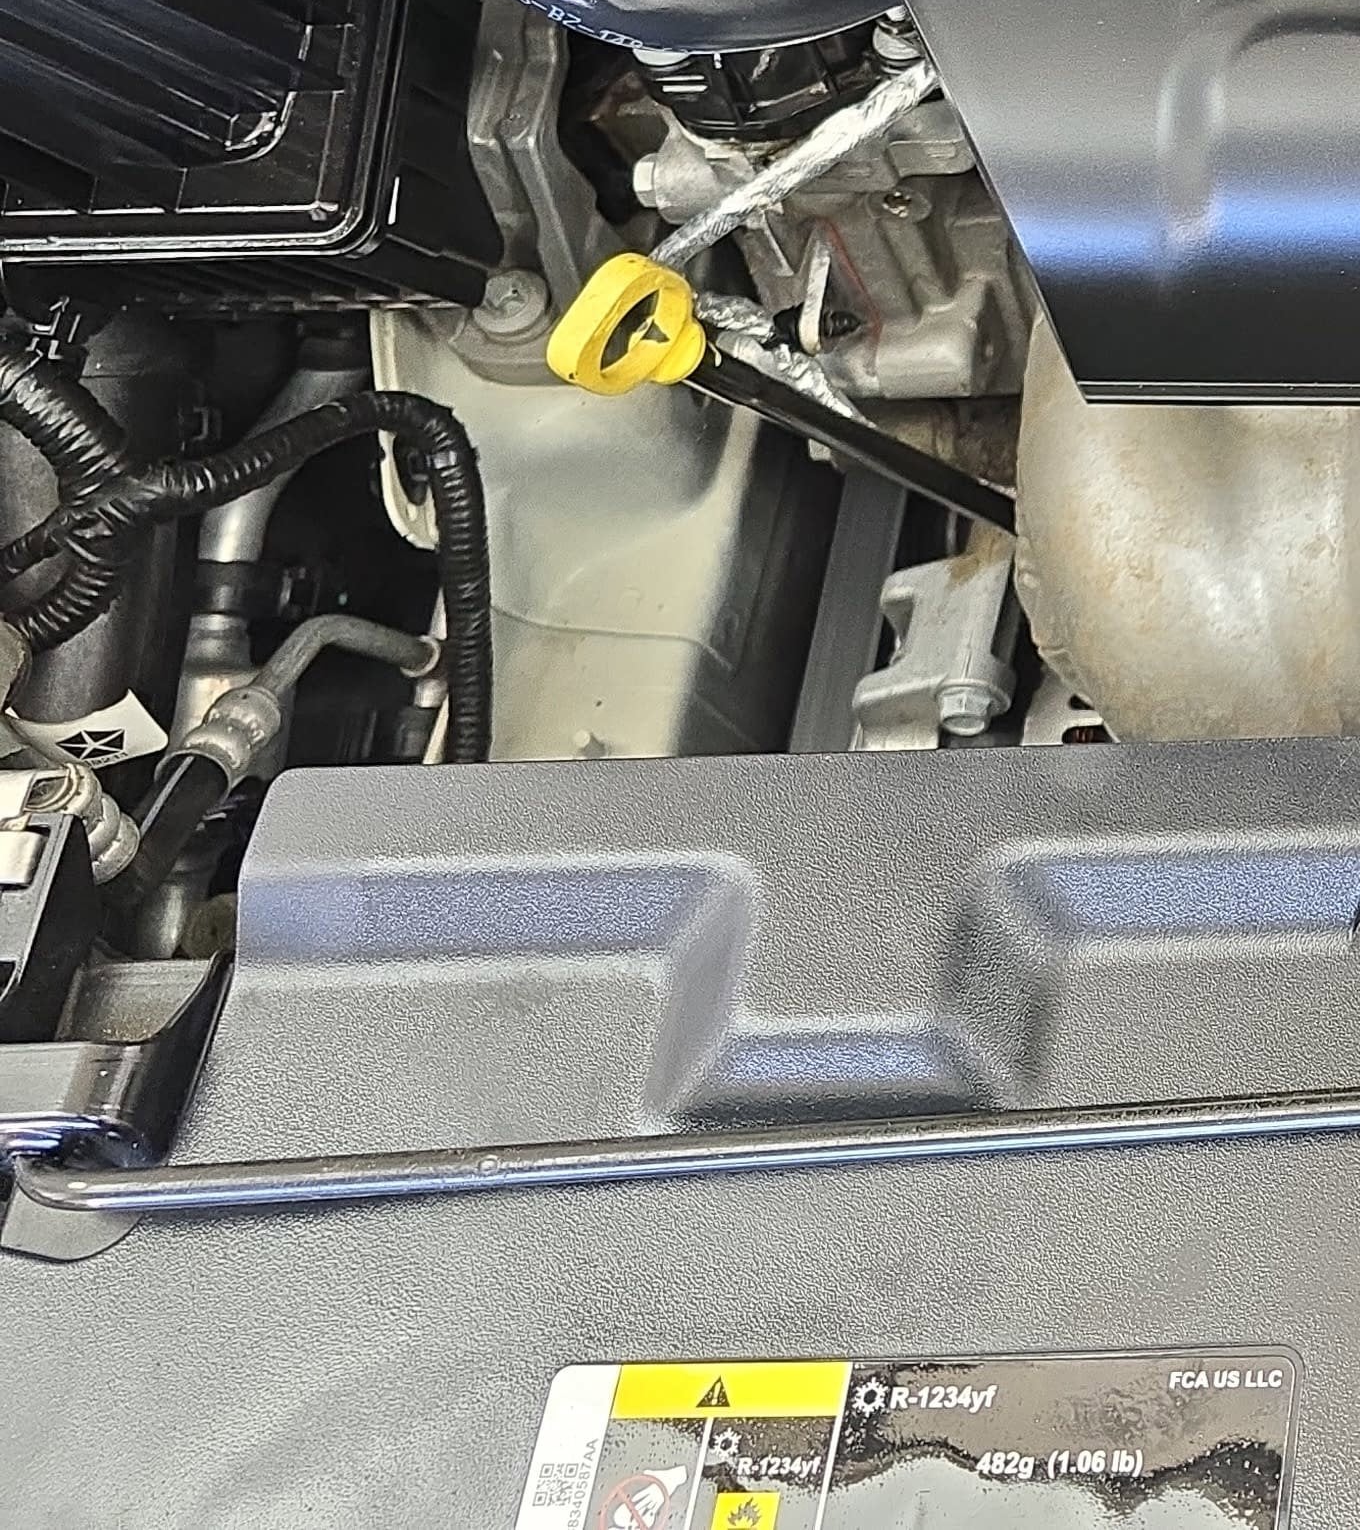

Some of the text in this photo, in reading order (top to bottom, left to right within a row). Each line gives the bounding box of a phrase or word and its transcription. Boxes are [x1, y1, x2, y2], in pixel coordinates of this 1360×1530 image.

[1168, 1368, 1284, 1391] FCA US LLC
[888, 1384, 998, 1413] R-1234yf
[736, 1455, 821, 1477] R-1234yf
[975, 1447, 1145, 1481] 482g (1.06 lb)
[567, 1437, 599, 1530] 8340587AA
